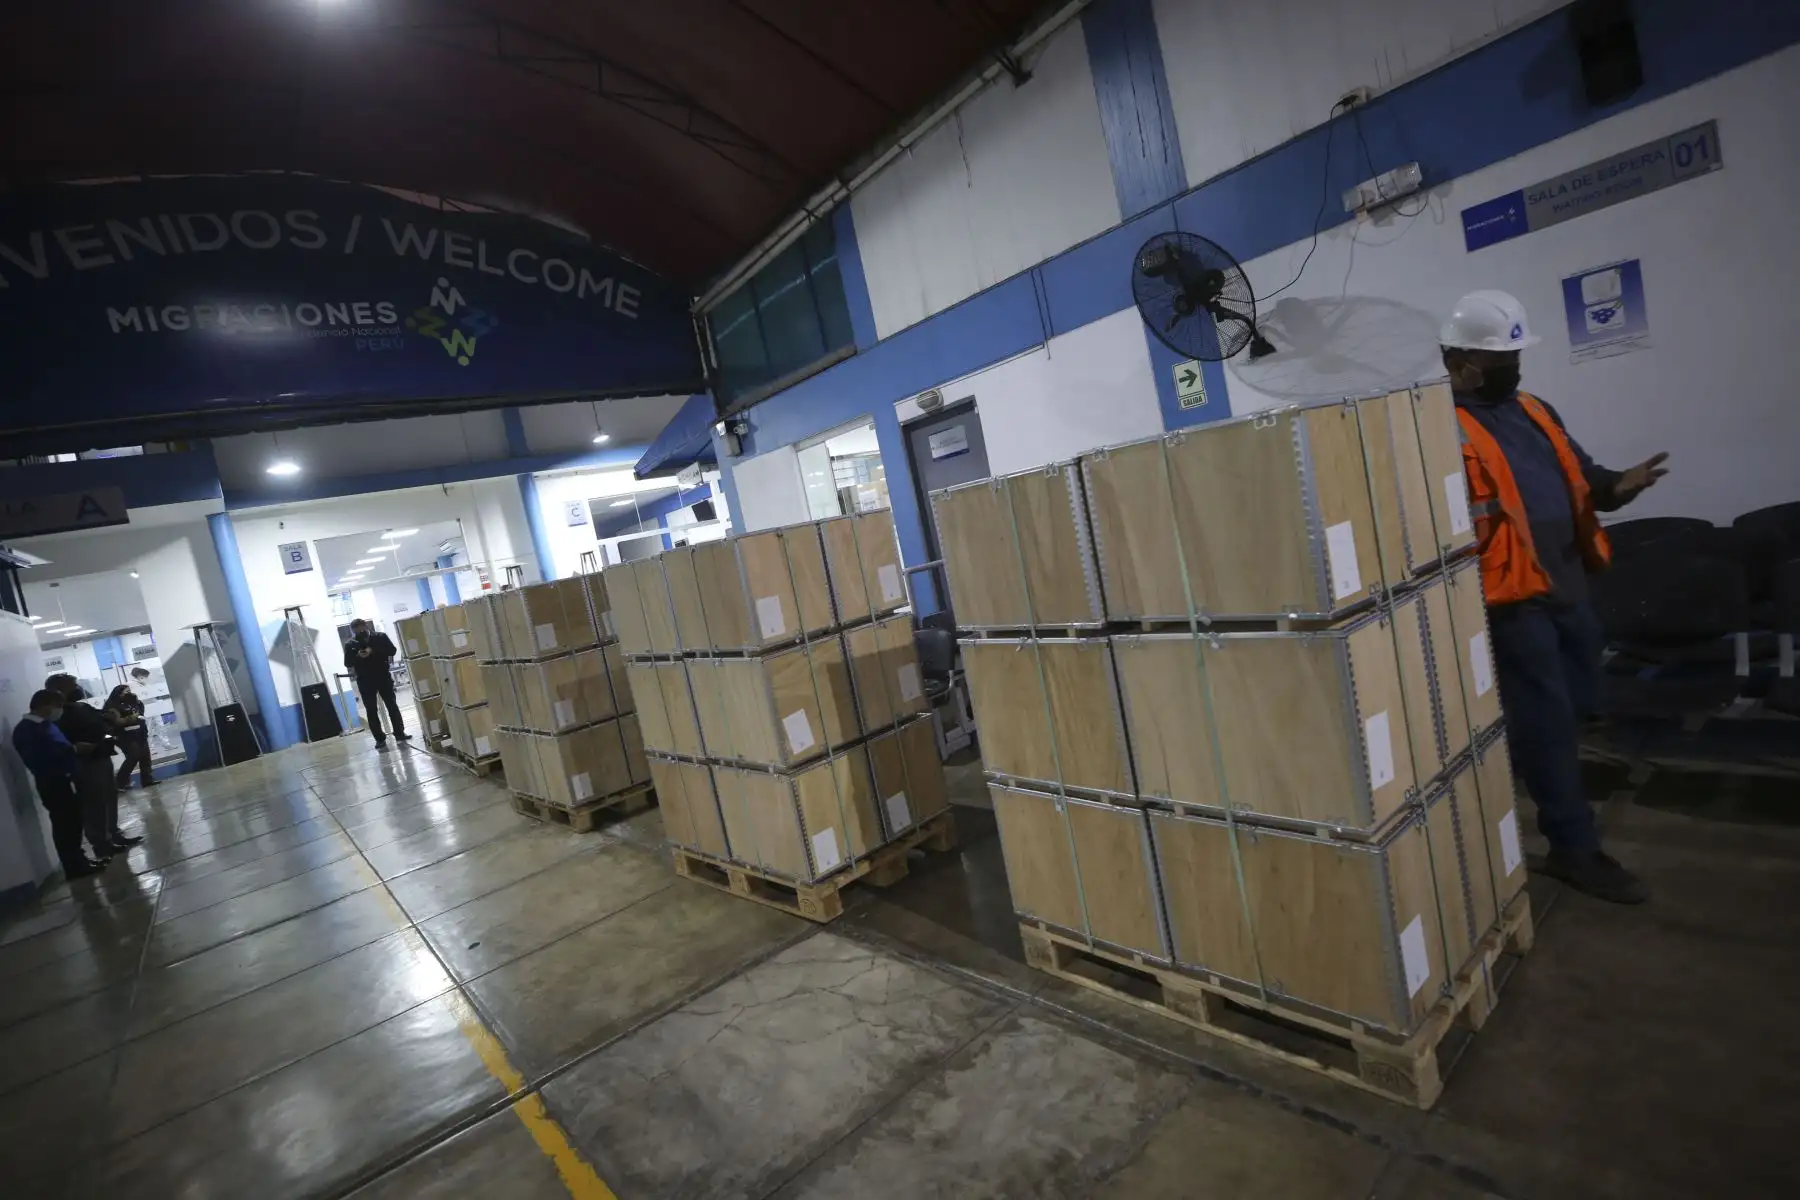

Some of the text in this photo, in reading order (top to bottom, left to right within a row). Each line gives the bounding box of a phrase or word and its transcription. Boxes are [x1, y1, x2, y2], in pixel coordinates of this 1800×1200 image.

[1528, 134, 1709, 205] SALA DE ESPERA 01
[0, 209, 327, 290] VENIDOS
[378, 215, 643, 320] WELCOME
[105, 301, 398, 334] MIGRACIONES
[76, 494, 108, 520] A
[571, 507, 580, 517] C
[291, 551, 303, 562] B
